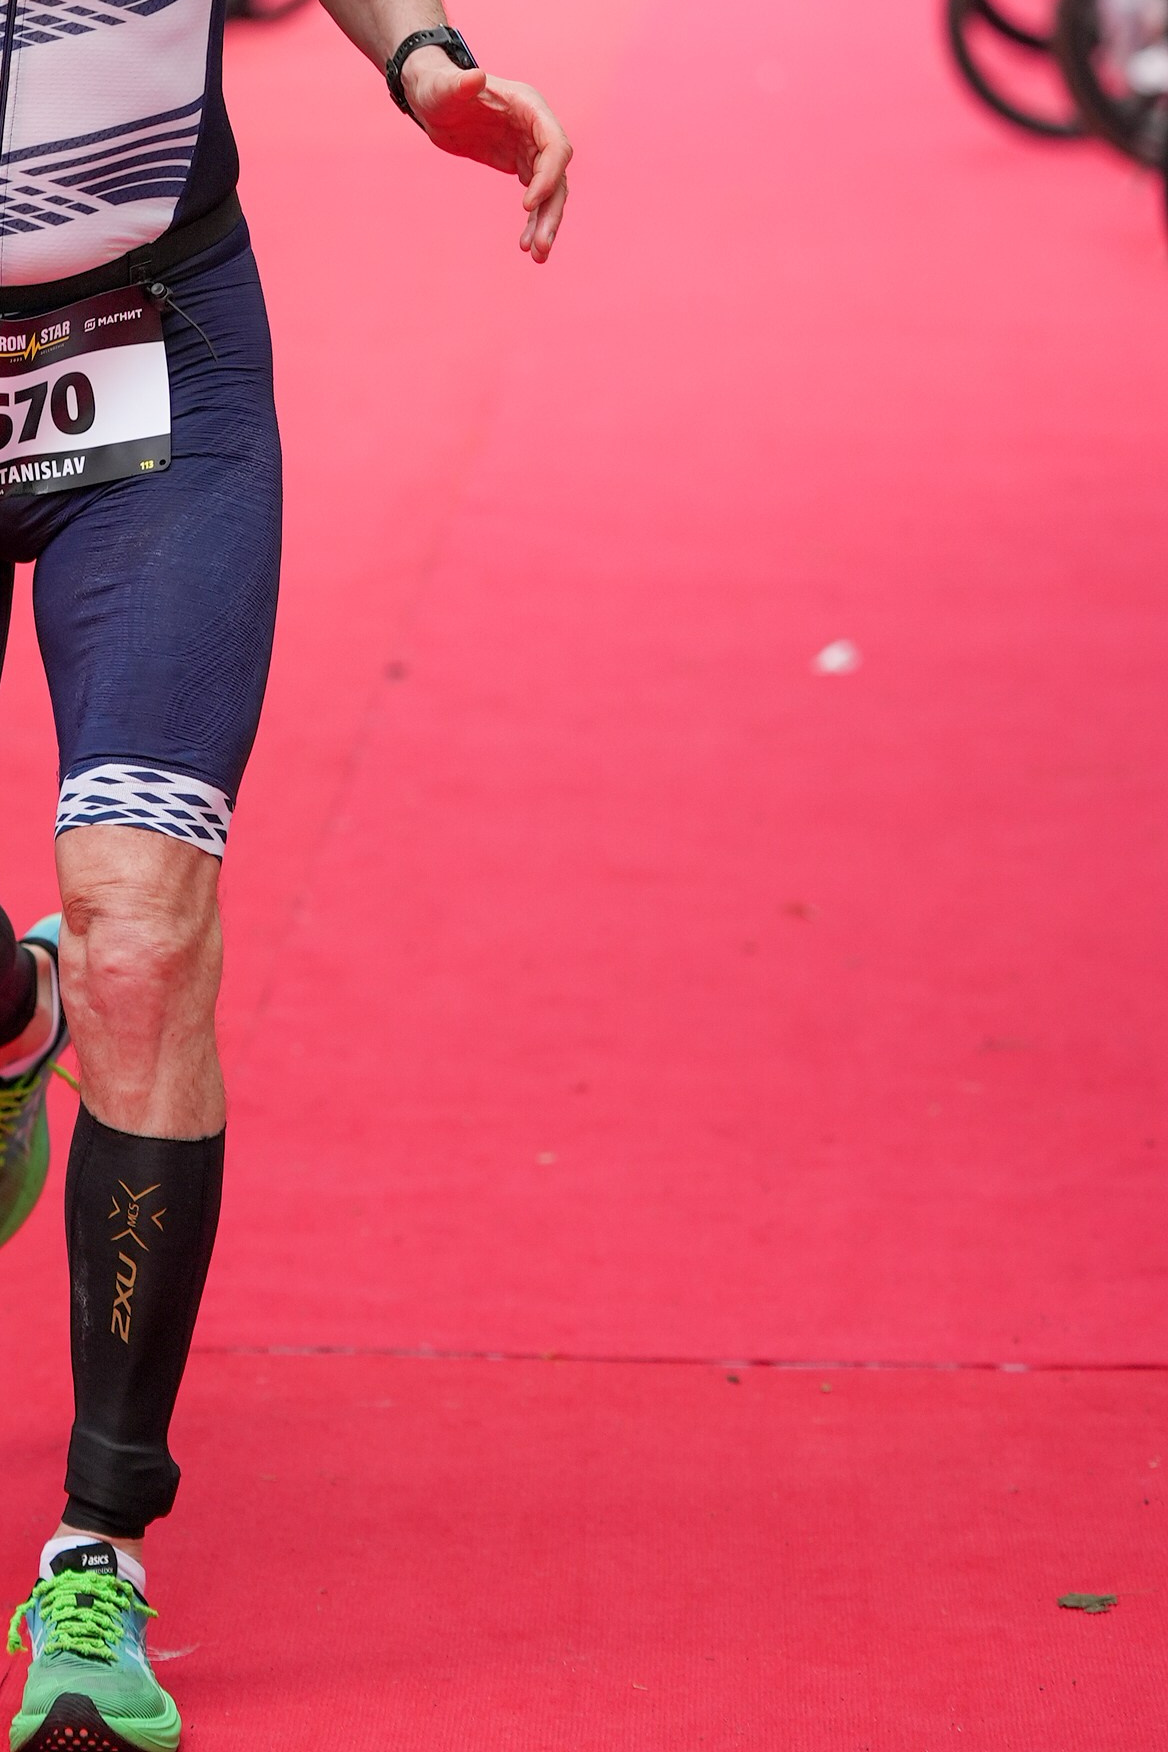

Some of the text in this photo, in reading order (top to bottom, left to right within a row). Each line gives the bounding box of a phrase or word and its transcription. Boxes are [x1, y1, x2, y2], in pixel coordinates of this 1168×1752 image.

[98, 308, 143, 327] МАГНИТ
[40, 320, 71, 344] STAR
[139, 459, 154, 470] 113
[127, 1202, 139, 1228] MCS
[111, 1251, 138, 1344] 2XU
[87, 1554, 109, 1566] asics
